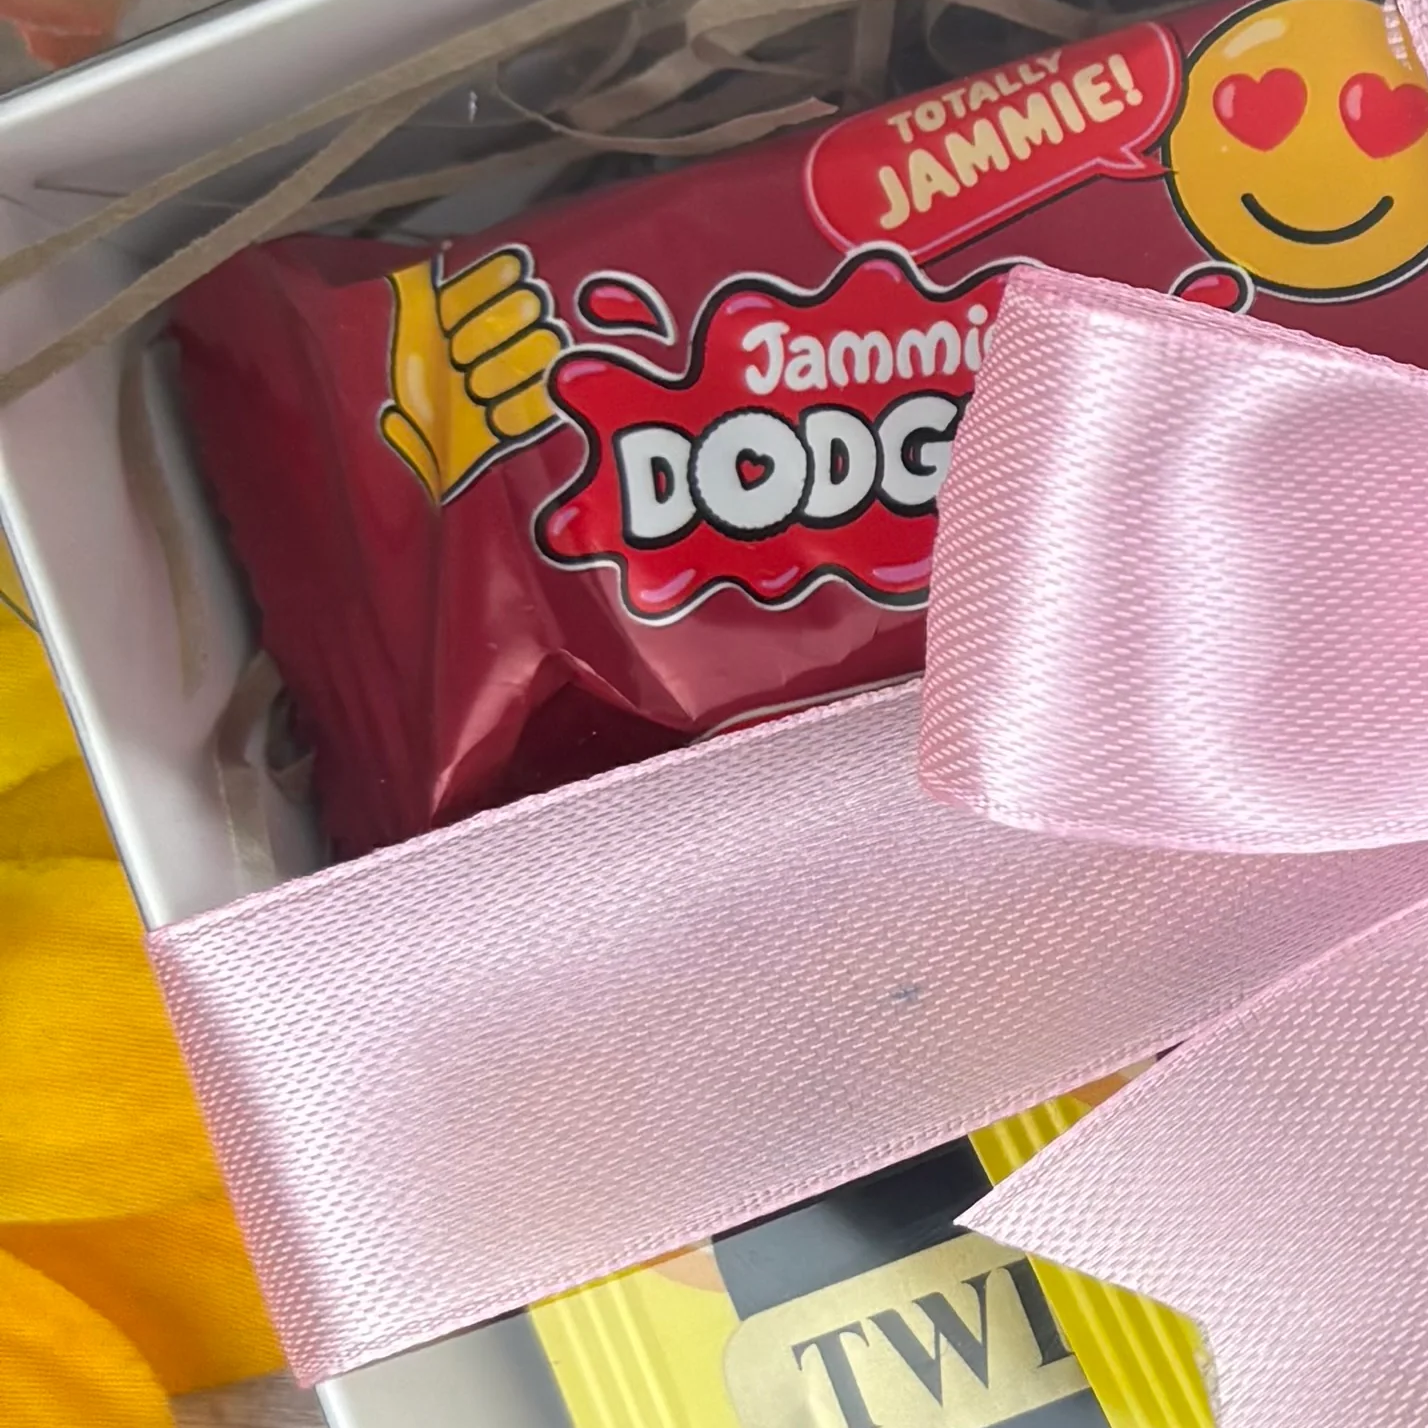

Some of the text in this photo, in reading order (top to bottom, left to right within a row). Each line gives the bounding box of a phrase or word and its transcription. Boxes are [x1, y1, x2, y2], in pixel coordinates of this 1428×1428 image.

[878, 53, 1143, 230] JAMMIE!
[888, 52, 1062, 143] TOTALLY
[741, 305, 998, 394] Jammi
[615, 395, 958, 542] DODG
